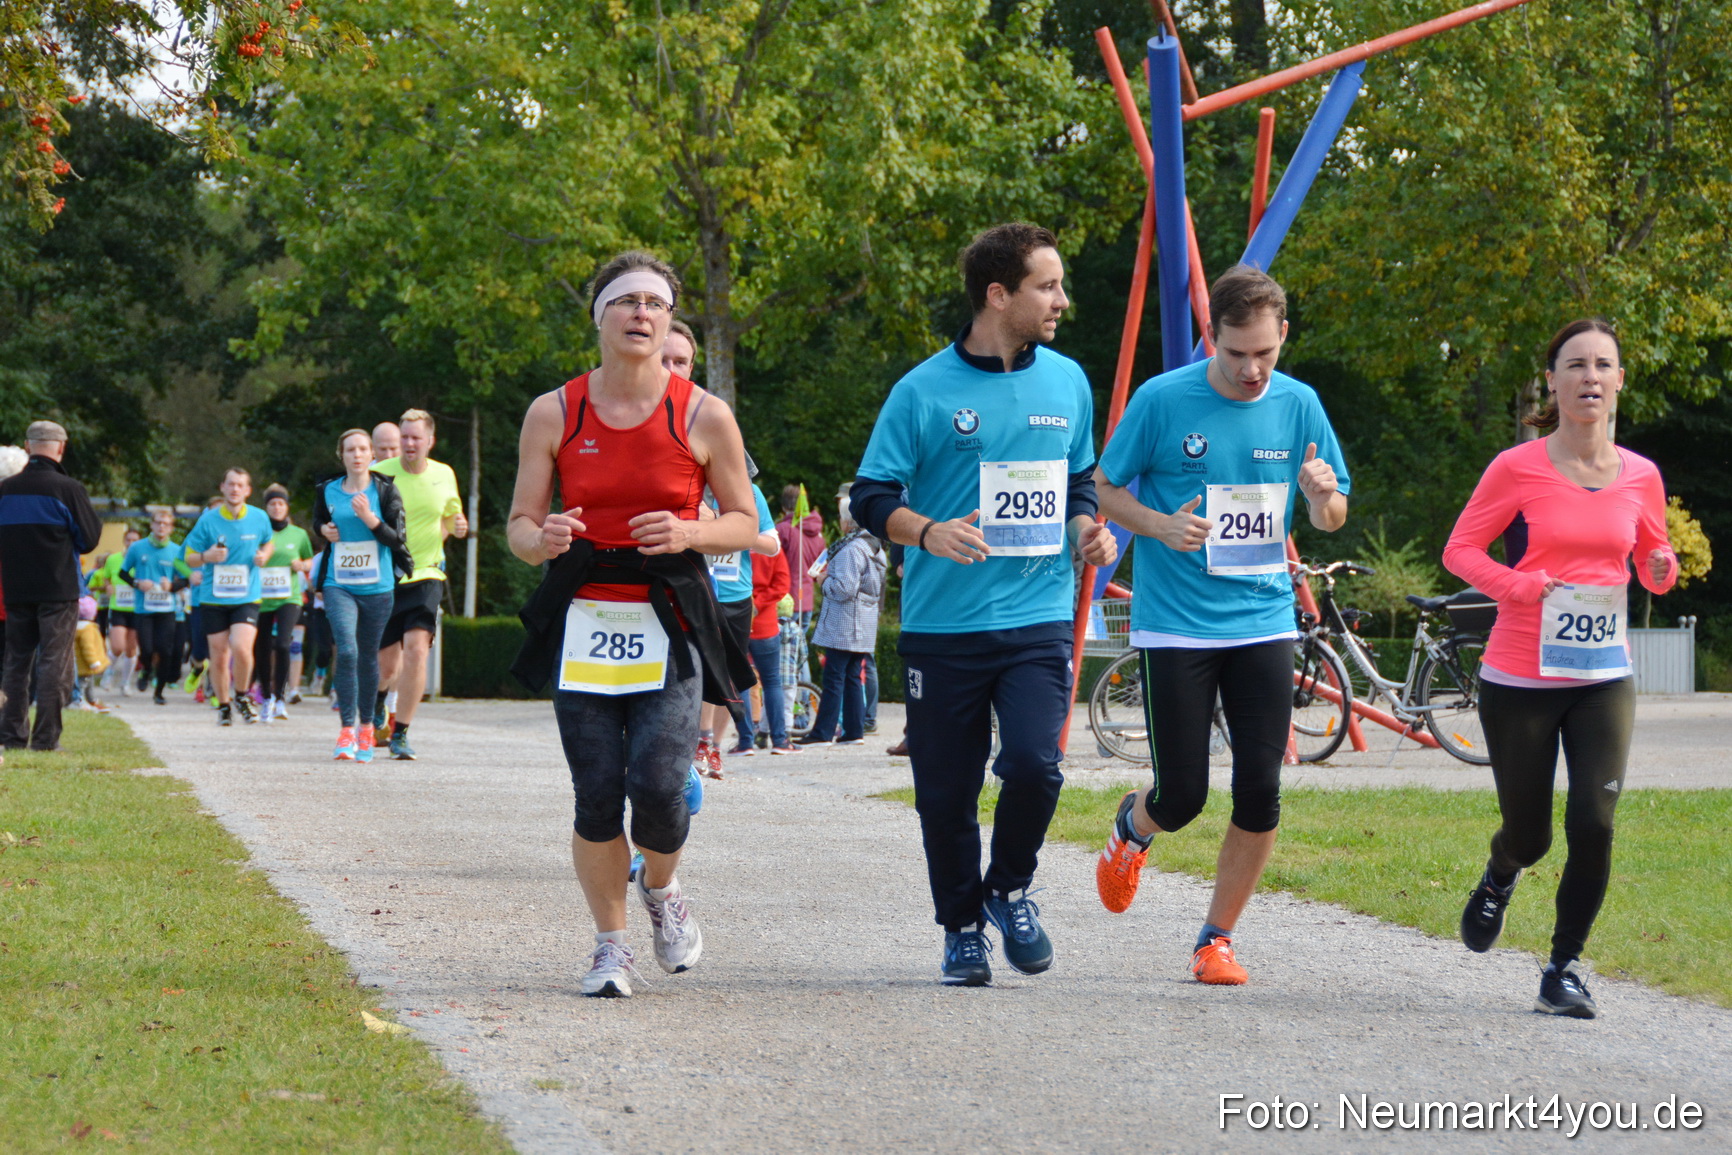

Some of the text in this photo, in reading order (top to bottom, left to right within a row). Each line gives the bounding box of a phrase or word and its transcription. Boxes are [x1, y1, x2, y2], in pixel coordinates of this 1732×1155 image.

[1028, 415, 1069, 428] BOCK
[955, 438, 982, 447] PARTL
[1253, 449, 1290, 460] BOCK
[1017, 470, 1047, 478] BOCK
[995, 490, 1056, 519] 2938
[1219, 511, 1272, 539] 2941
[996, 527, 1049, 545] Thomas
[340, 554, 371, 568] 2207
[218, 574, 243, 584] 2373
[263, 576, 286, 586] 2215
[606, 612, 641, 620] BOCK
[1555, 612, 1616, 642] 2934
[588, 631, 644, 660] 285
[1545, 649, 1575, 665] Andrea
